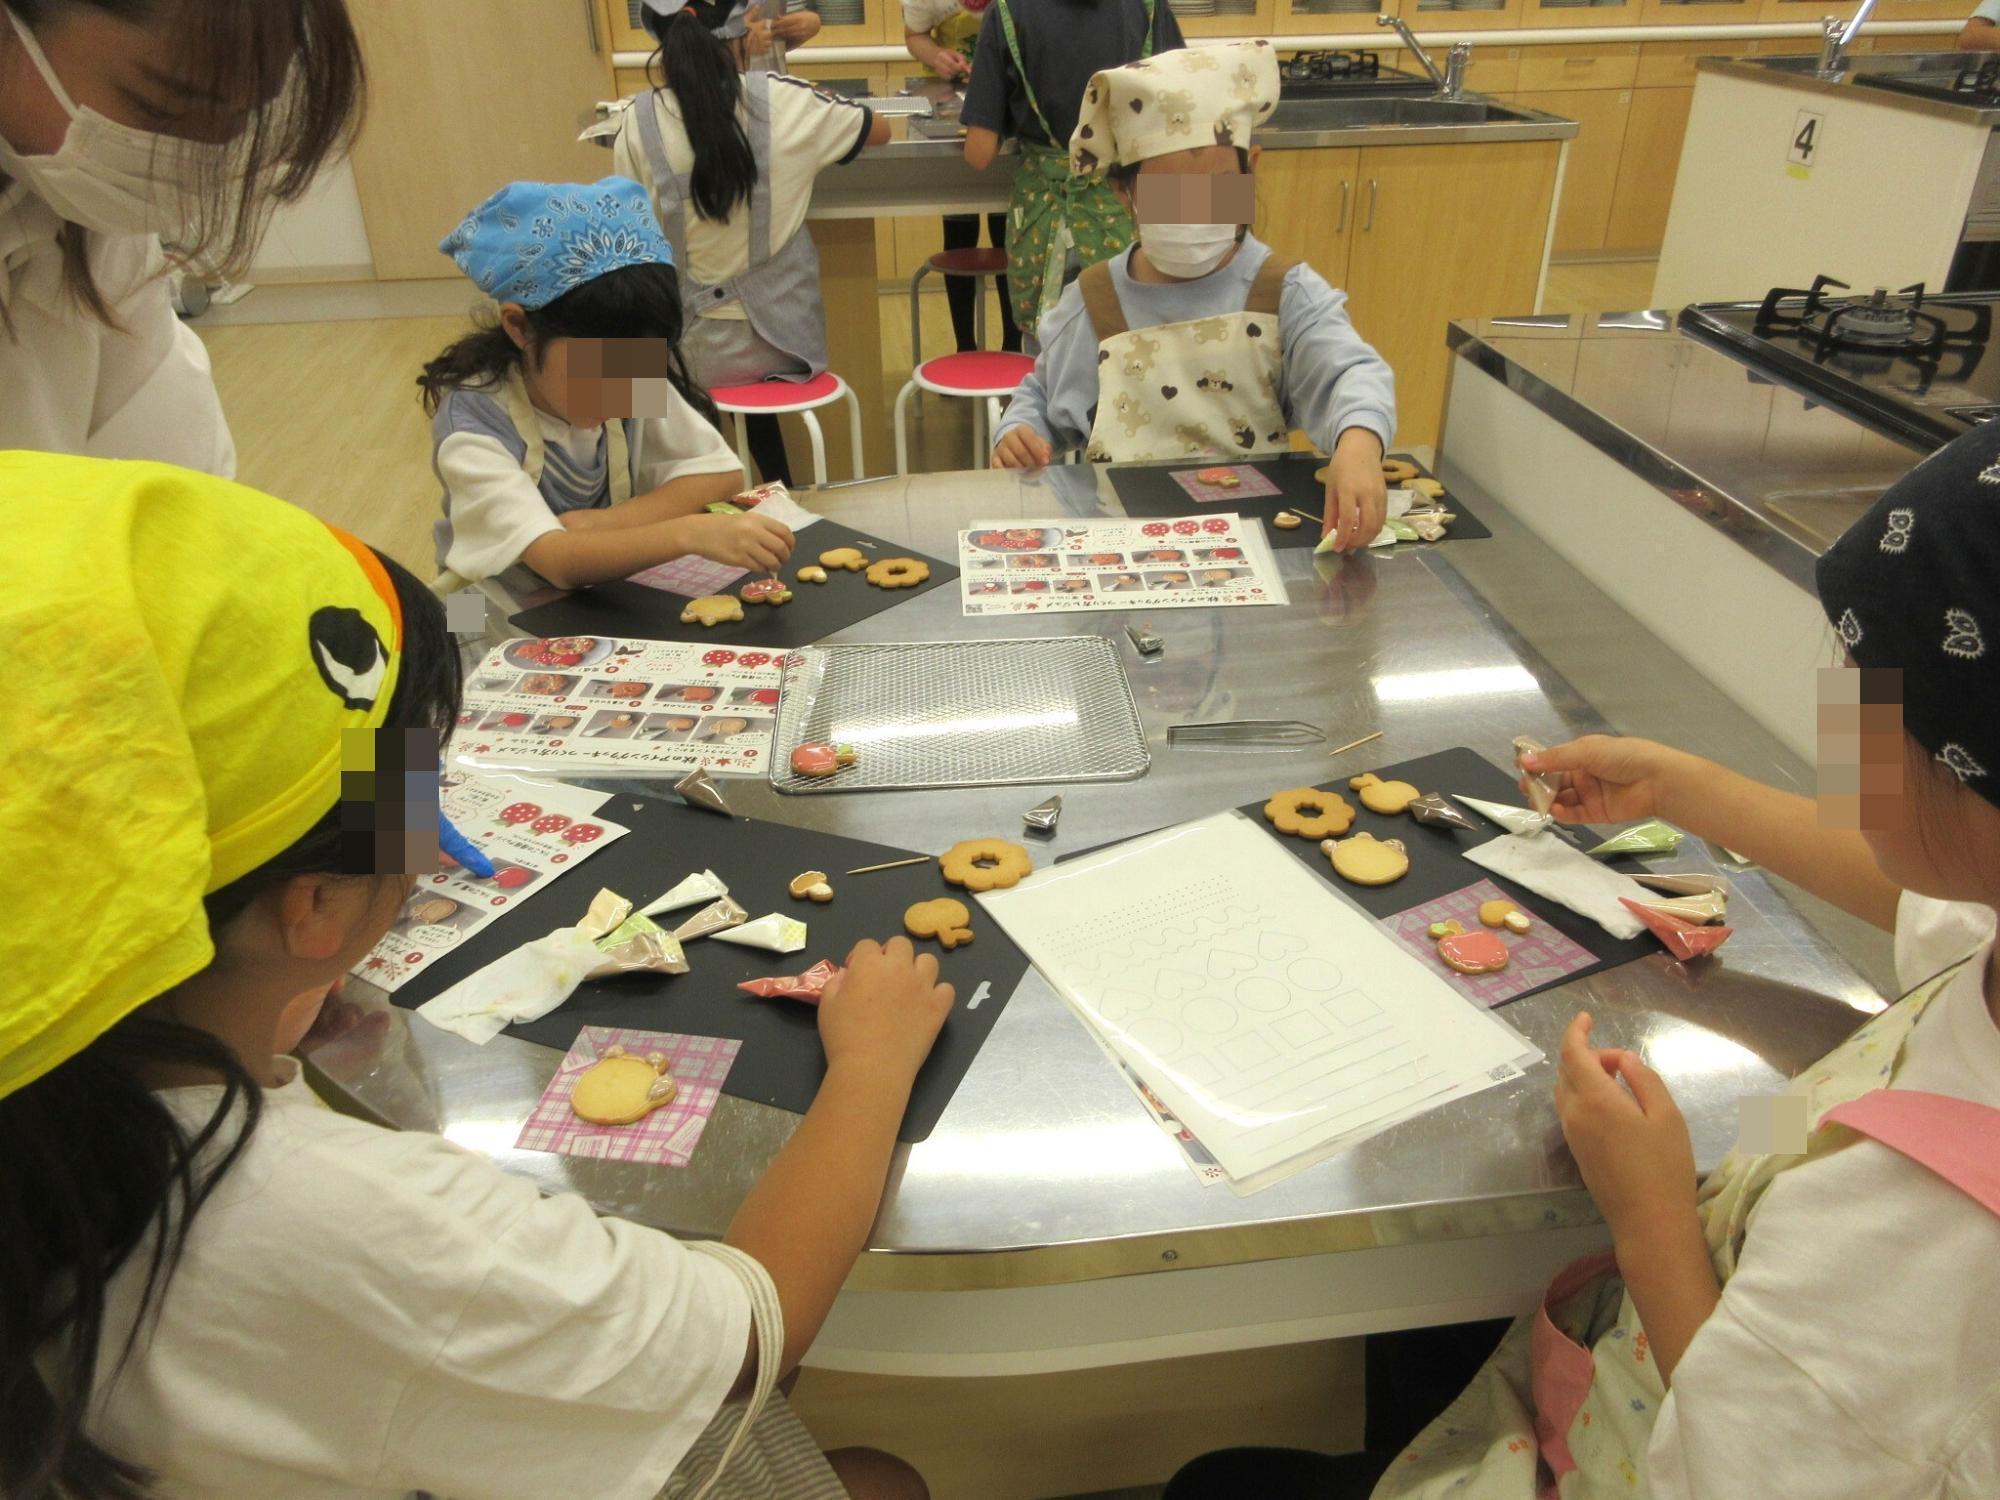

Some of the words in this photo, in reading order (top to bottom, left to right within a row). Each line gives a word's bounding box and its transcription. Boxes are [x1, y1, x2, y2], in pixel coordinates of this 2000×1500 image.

[1794, 119, 1816, 159] 4
[497, 747, 578, 757] つくり方レジュメ
[583, 750, 697, 763] 秋のアイシングクッキー
